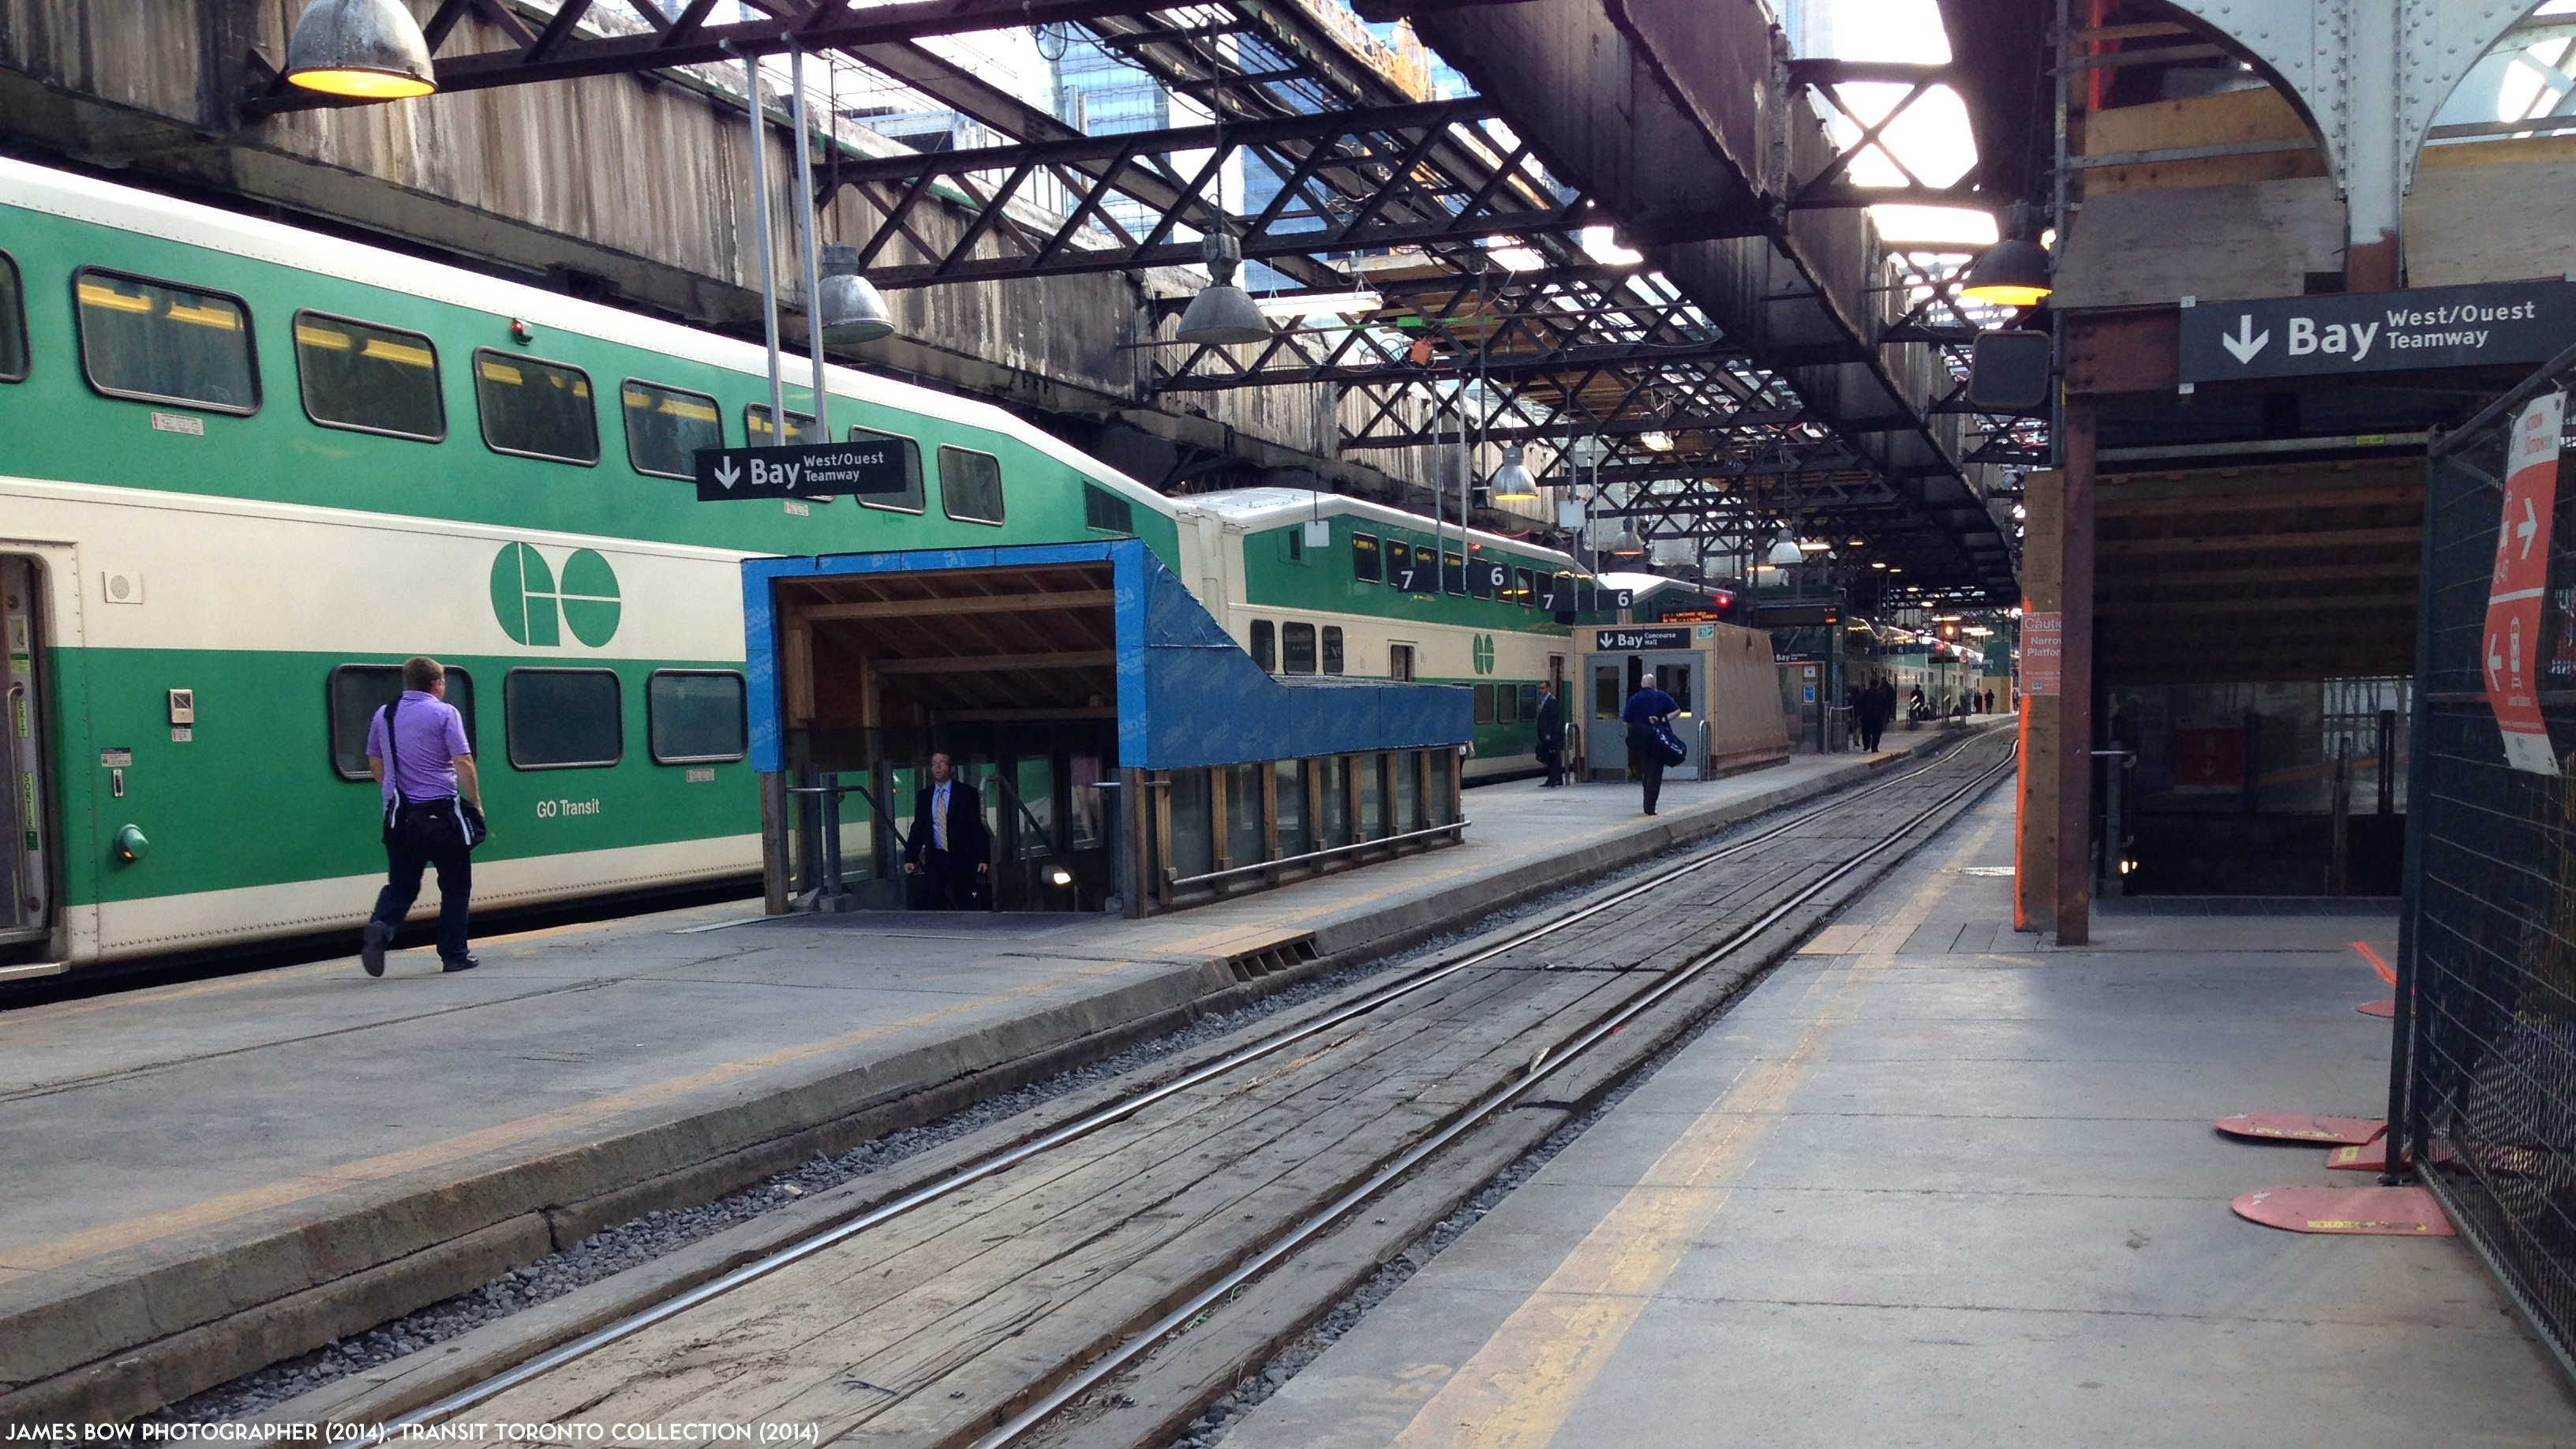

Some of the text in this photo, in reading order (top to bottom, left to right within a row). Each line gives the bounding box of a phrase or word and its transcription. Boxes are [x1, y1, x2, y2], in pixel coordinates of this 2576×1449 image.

[2386, 301, 2536, 327] West/Ouest
[2289, 317, 2379, 362] Bay
[2386, 330, 2489, 349] Teamway
[803, 451, 885, 467] West/Ouest
[751, 459, 800, 489] Bay
[804, 470, 860, 482] Teamway
[1401, 567, 1504, 590] 7 6
[1543, 591, 1629, 609] 7 6
[1618, 634, 1643, 648] Bay
[537, 798, 600, 818] GO Transit
